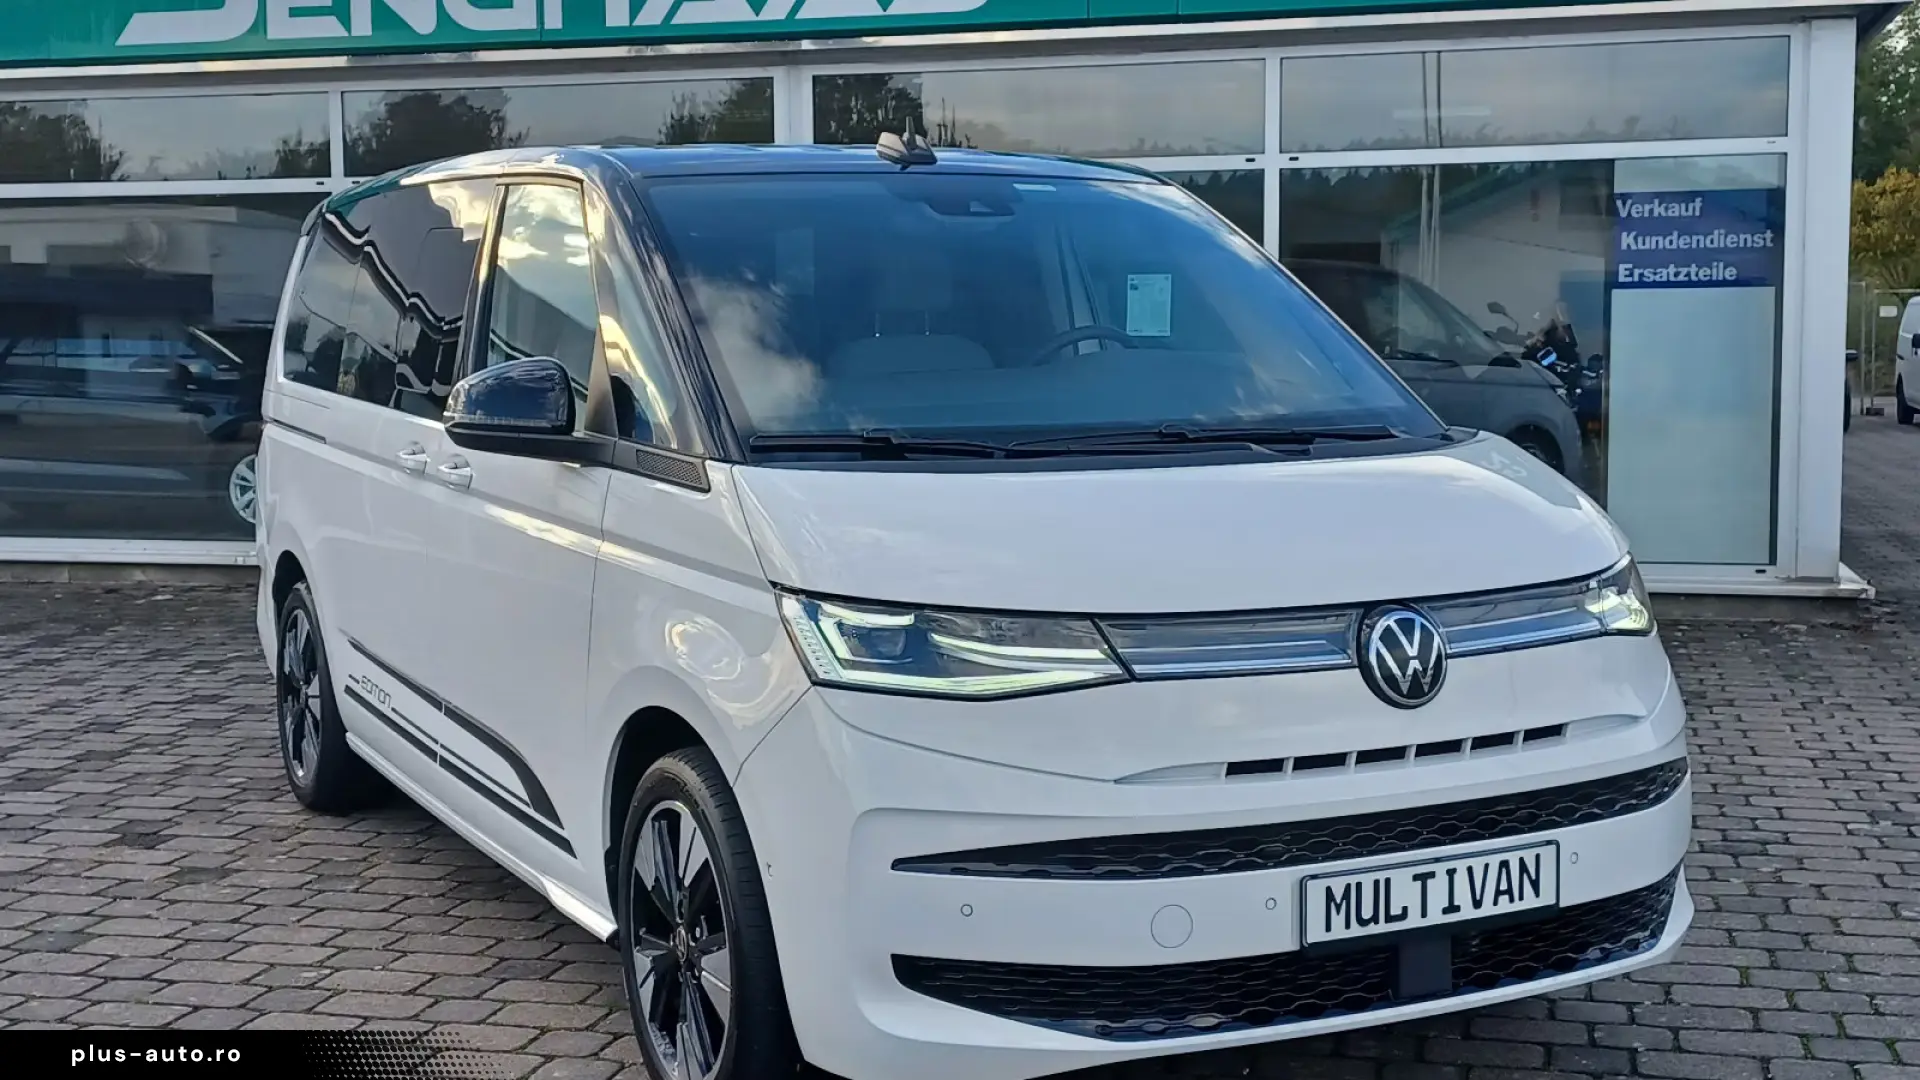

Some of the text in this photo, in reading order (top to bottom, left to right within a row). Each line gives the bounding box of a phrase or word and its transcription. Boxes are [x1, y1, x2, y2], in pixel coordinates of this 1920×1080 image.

[1616, 198, 1703, 218] Verkauf
[1620, 230, 1774, 251] Kundendienst
[1617, 261, 1738, 283] Ersatzteile
[1324, 853, 1541, 933] MULTIVAN
